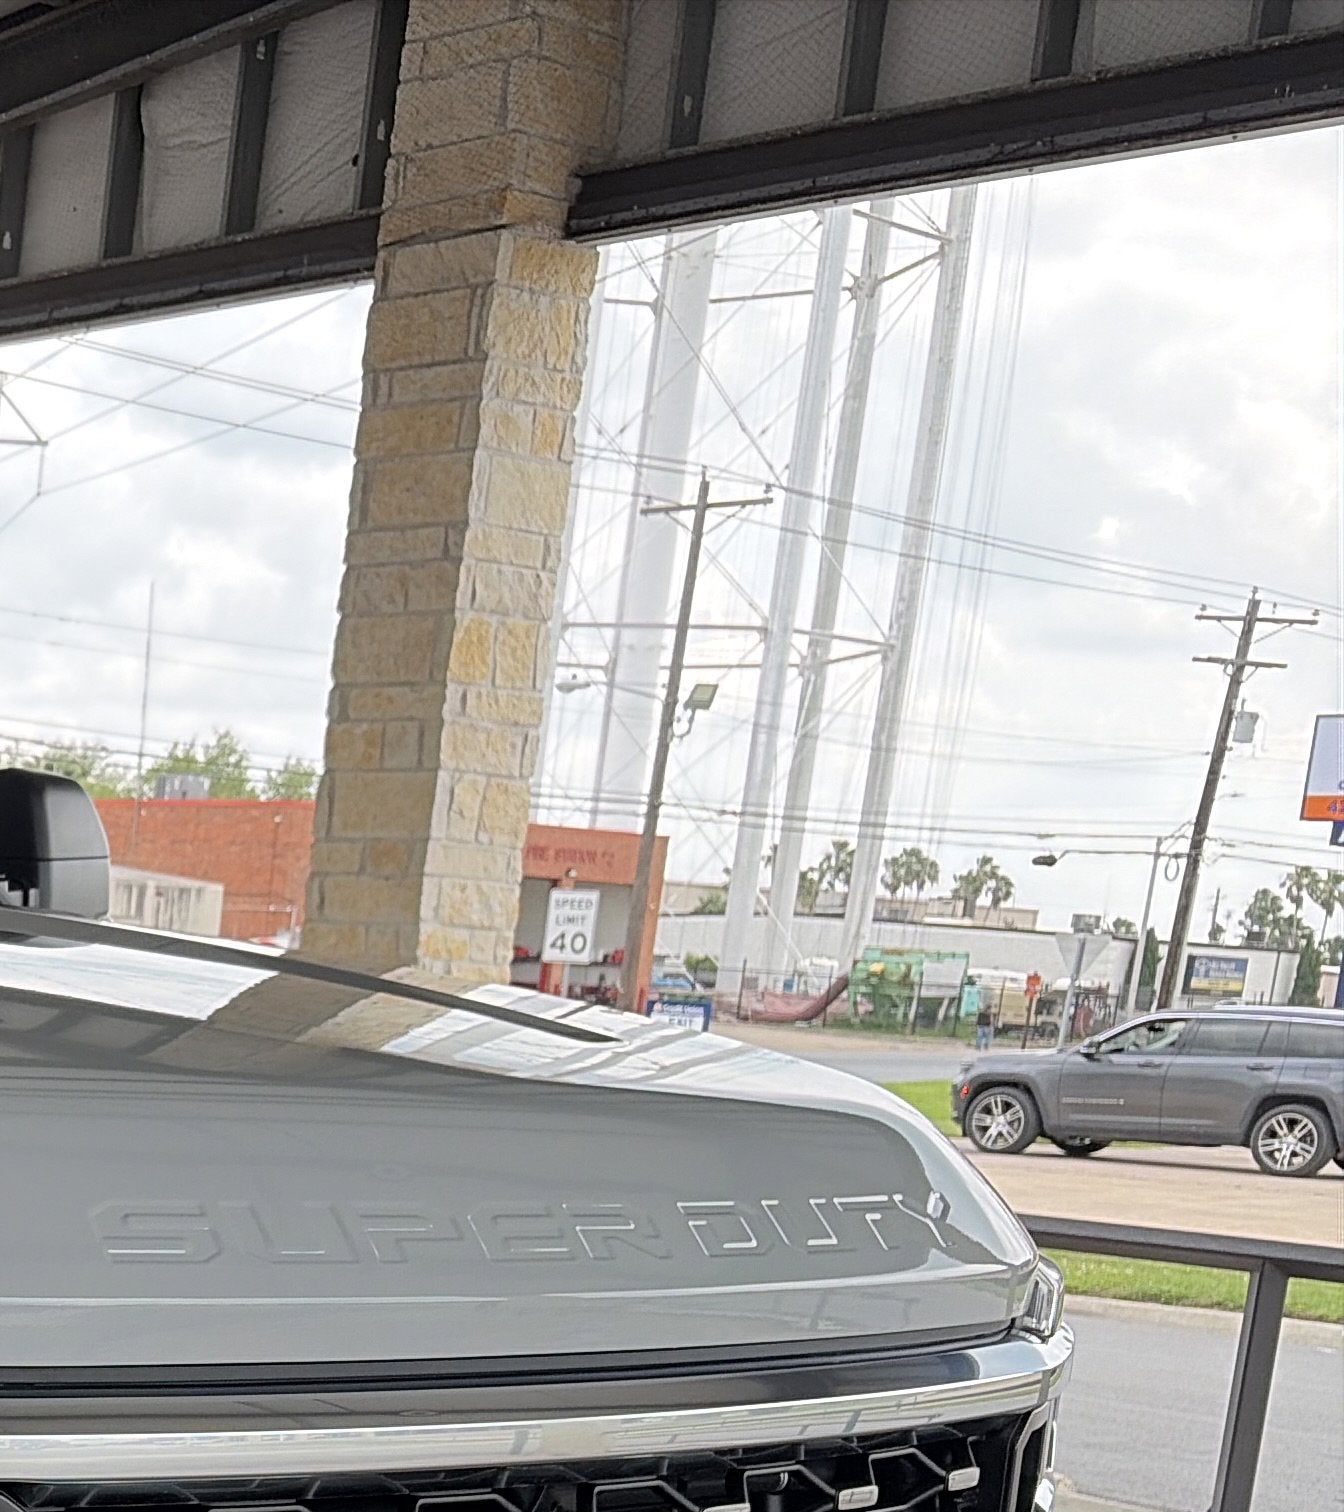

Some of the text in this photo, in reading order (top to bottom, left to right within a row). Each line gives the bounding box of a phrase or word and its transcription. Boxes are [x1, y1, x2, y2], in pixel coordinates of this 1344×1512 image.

[554, 896, 593, 911] SPEED
[555, 914, 587, 927] LIMIT
[550, 930, 588, 955] 40
[92, 1191, 954, 1264] SUPER DUTY
